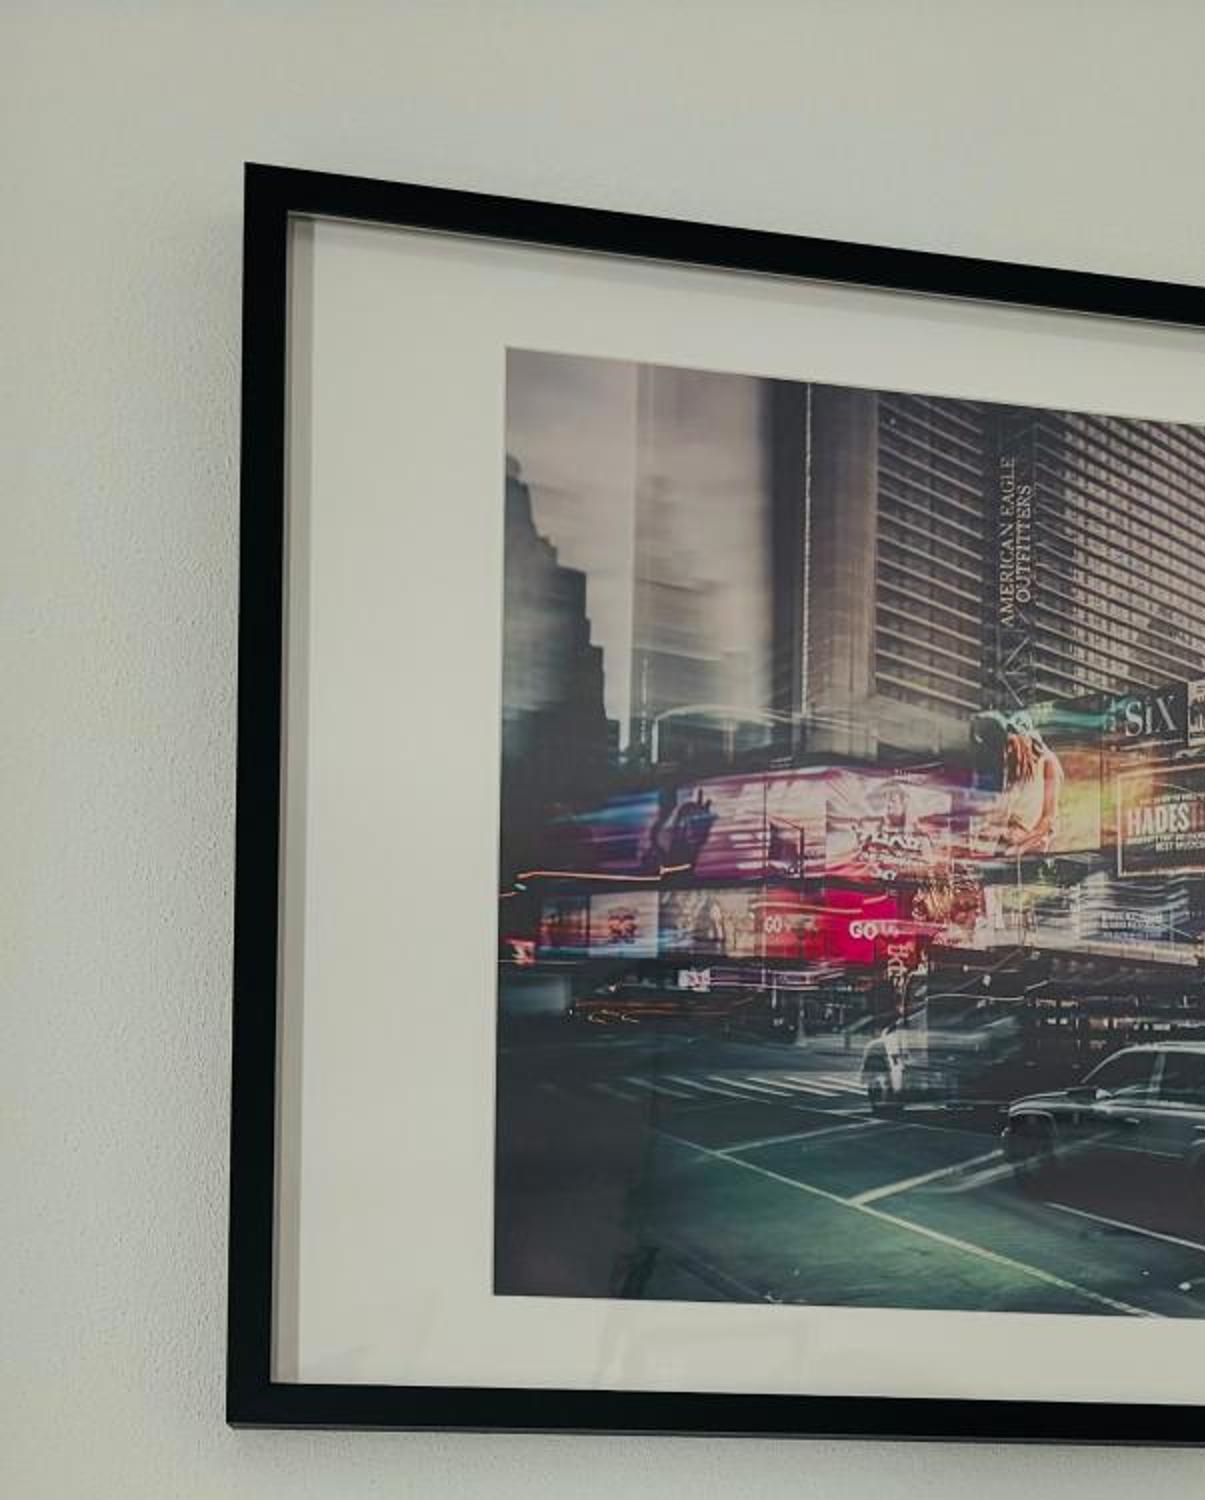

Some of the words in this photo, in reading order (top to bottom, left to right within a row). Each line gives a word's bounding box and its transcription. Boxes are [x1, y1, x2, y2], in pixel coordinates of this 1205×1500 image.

[1000, 456, 1016, 518] EAGLE
[1000, 523, 1016, 628] AMERICAN
[1016, 484, 1032, 603] OUTFITTERS
